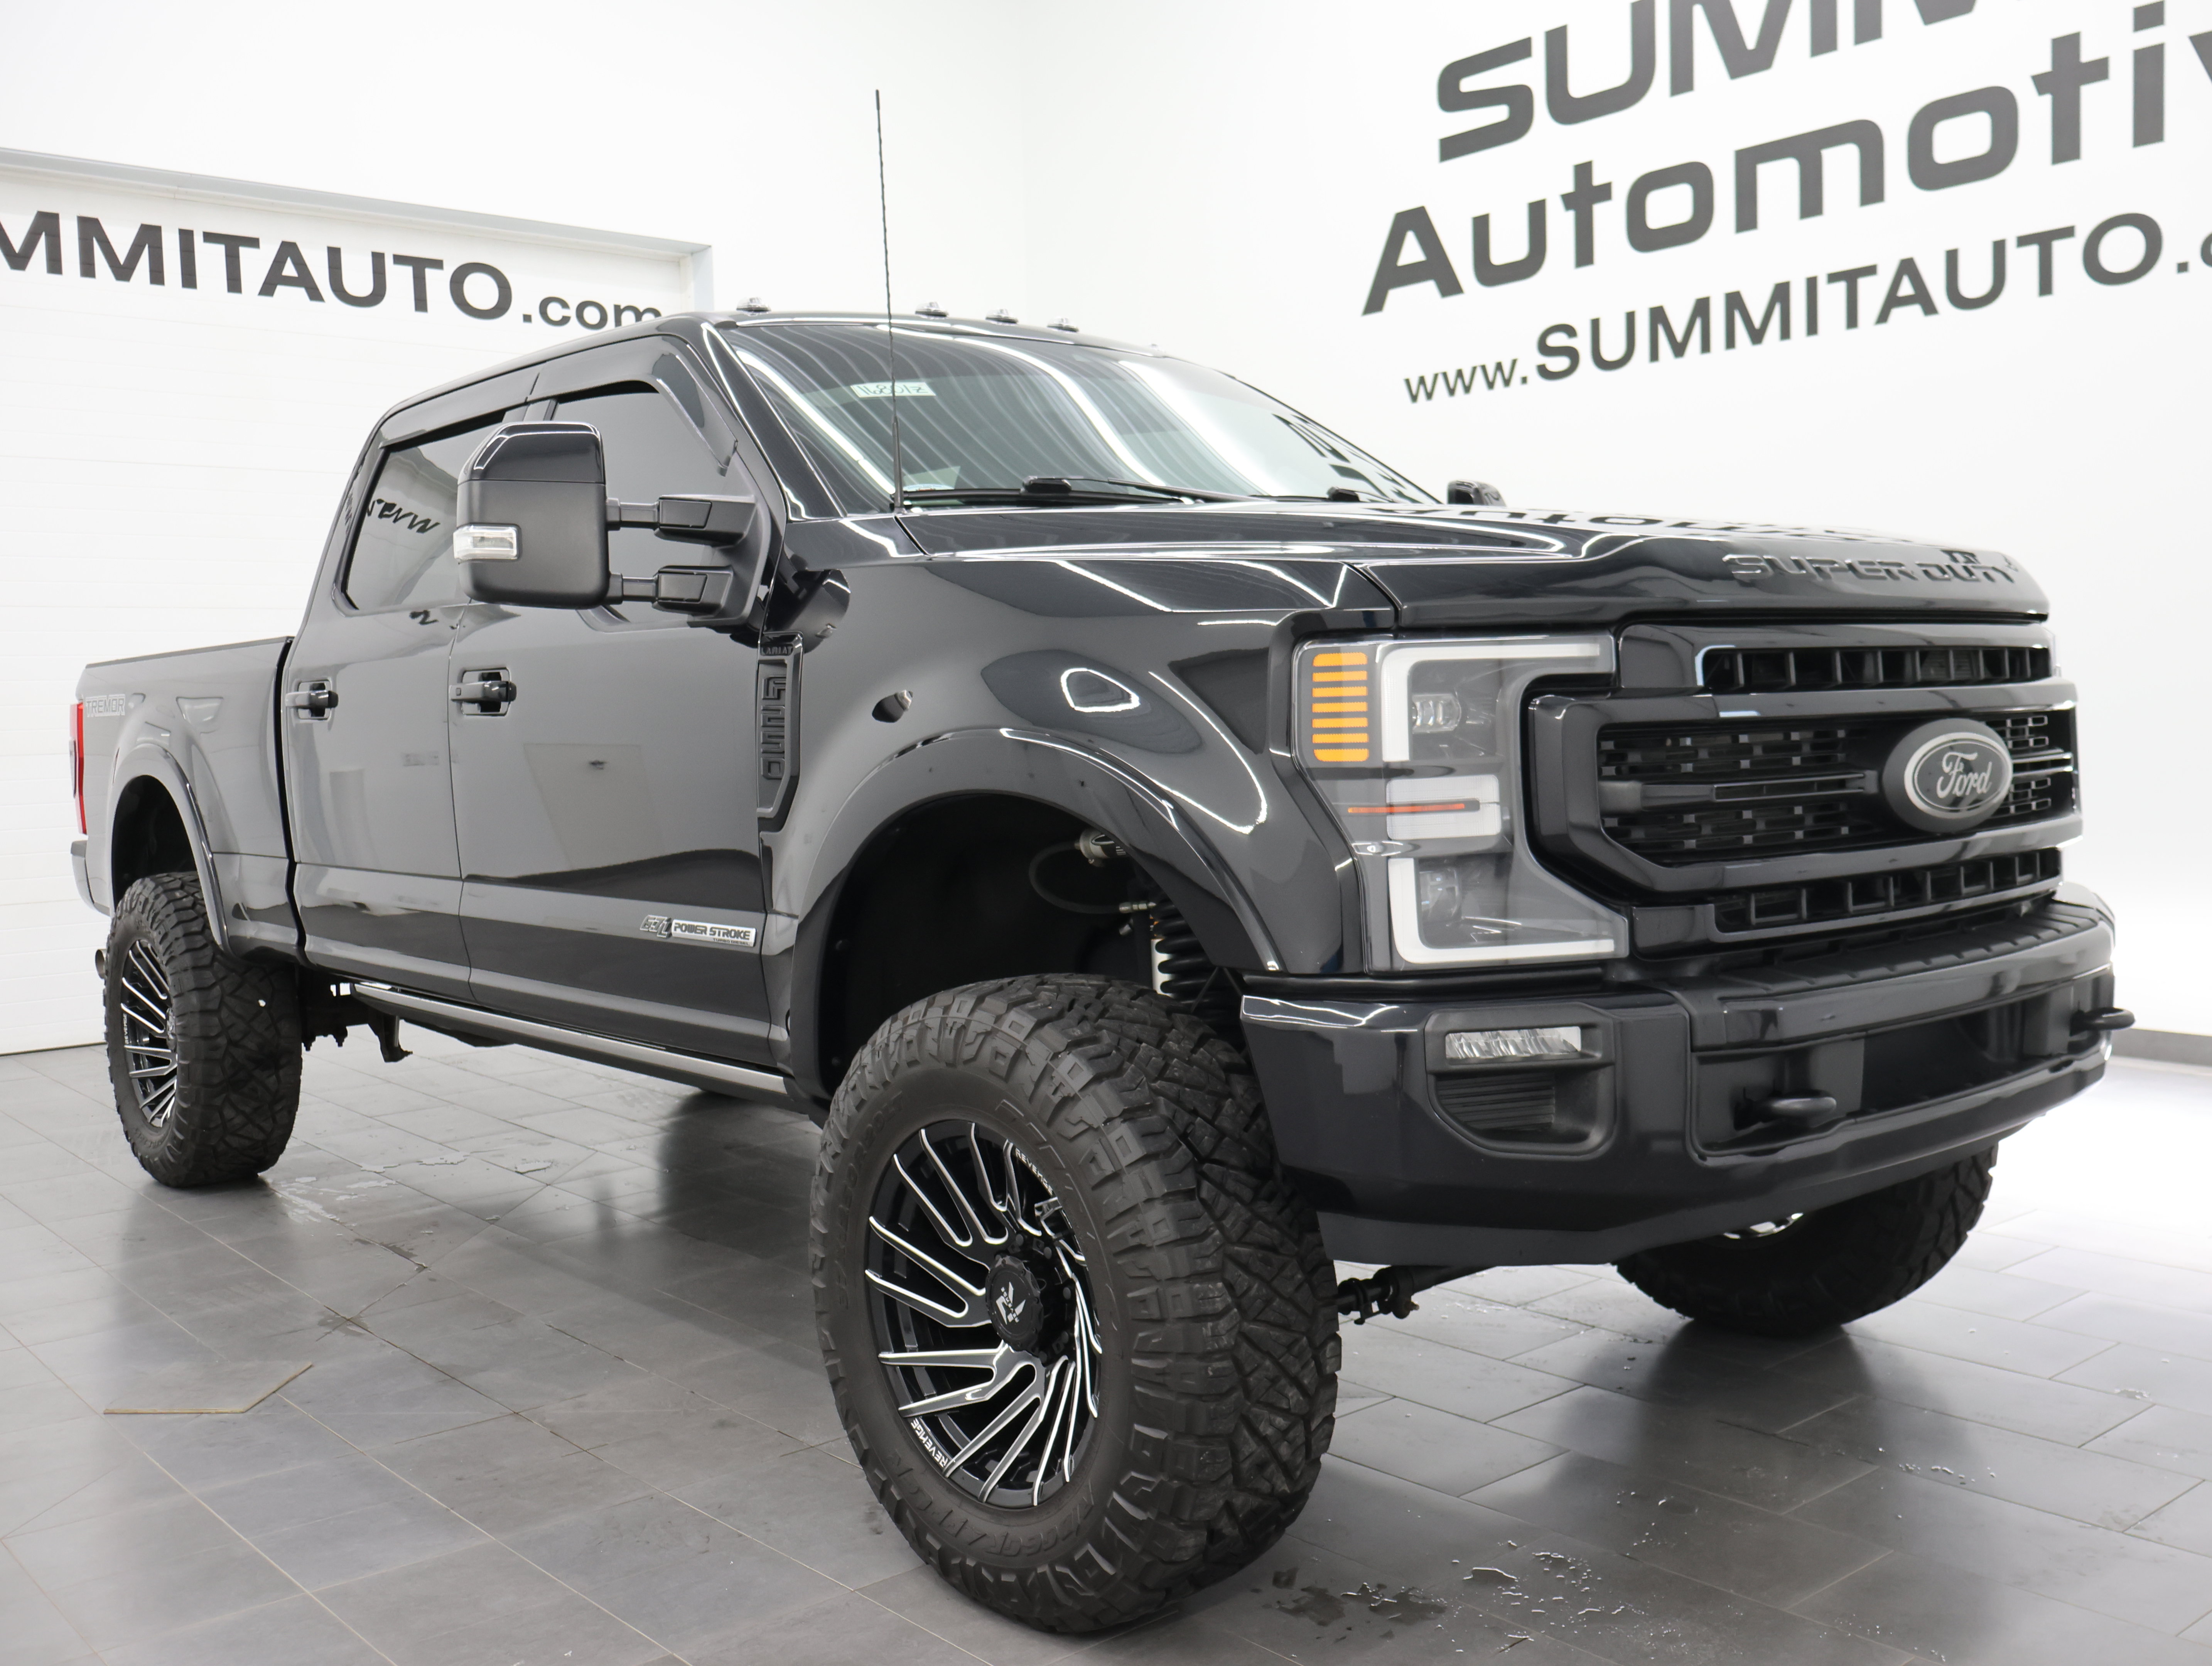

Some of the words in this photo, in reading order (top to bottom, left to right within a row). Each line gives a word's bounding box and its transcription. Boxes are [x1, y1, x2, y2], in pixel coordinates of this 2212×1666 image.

[1438, 0, 1976, 162] SUM
[1363, 1, 2212, 315] Automoti
[1722, 553, 1919, 582] SUPER
[1914, 558, 2019, 583] DUTY
[760, 646, 793, 655] LARIAT
[85, 694, 125, 717] TREMOR
[1936, 752, 1992, 798] Ford
[673, 922, 707, 936] POWER
[709, 926, 751, 941] STROKE
[1015, 1147, 1053, 1196] REVENGE
[911, 1417, 948, 1468] REVENGE
